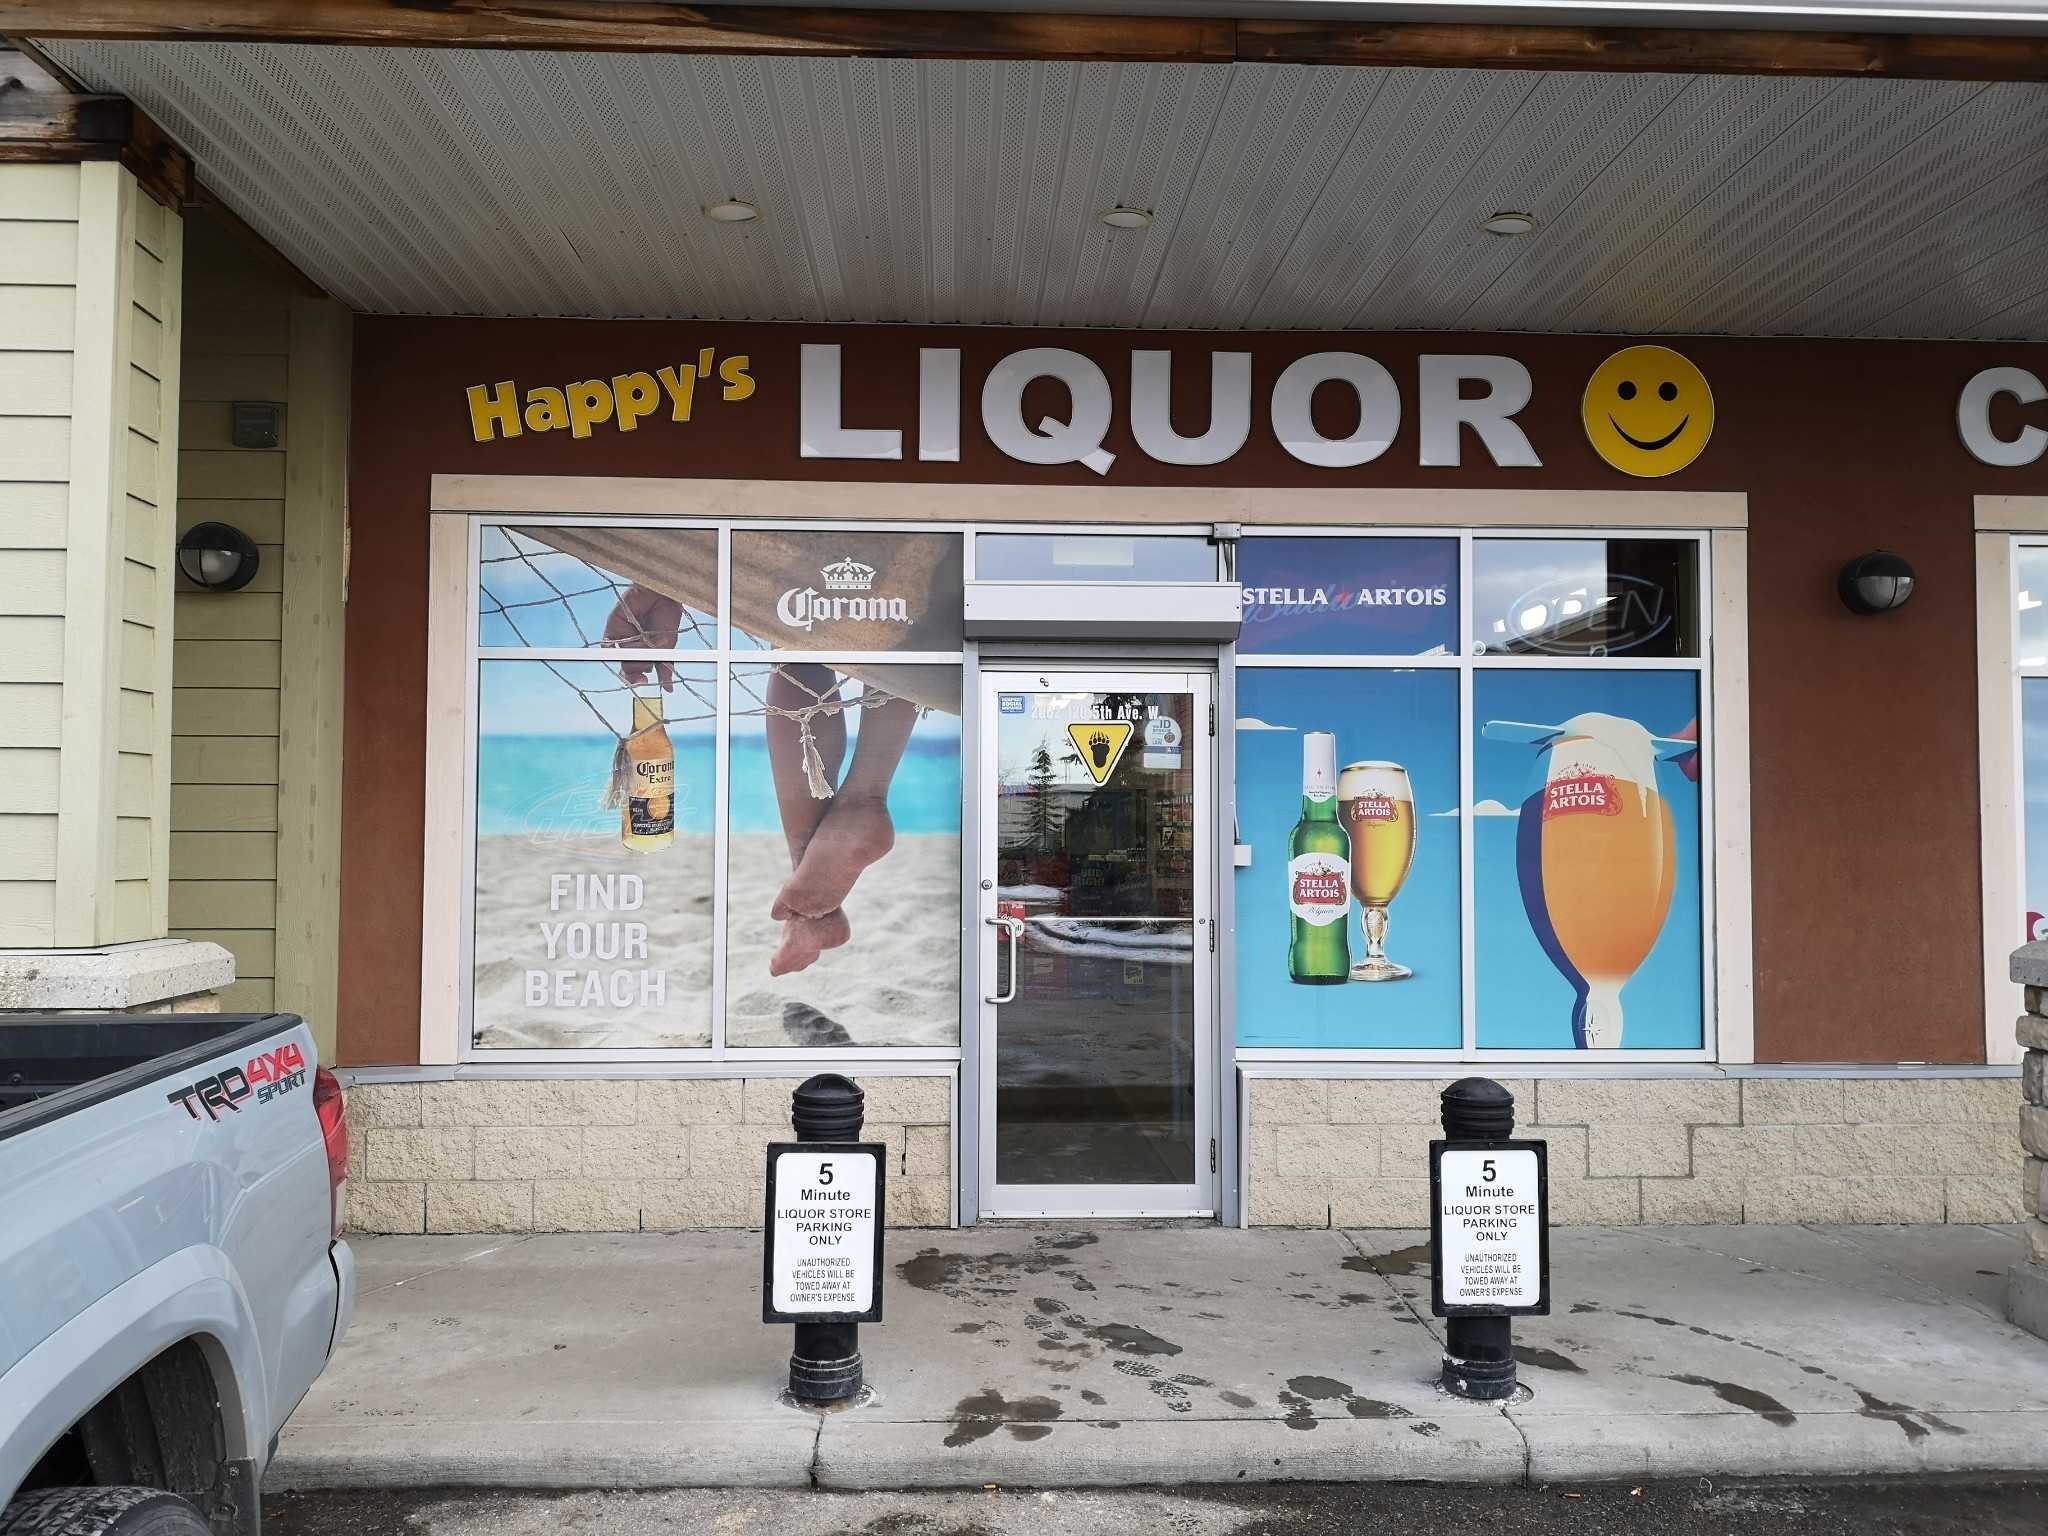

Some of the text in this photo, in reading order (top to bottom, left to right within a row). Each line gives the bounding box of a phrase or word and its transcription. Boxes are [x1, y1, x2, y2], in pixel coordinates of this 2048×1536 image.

[466, 343, 1544, 477] Happy's LIQUOR
[1242, 587, 1448, 606] STELLA ARTOIS
[776, 586, 910, 632] Corona
[1092, 705, 1112, 720] 5th
[1117, 705, 1143, 720] Ave.
[1148, 705, 1162, 720] W.
[1551, 782, 1605, 798] STELLA
[1358, 801, 1391, 809] STELLA
[1549, 794, 1606, 811] ARTOIS
[1358, 808, 1391, 816] ARTOIS
[1300, 879, 1339, 889] STELLA
[550, 873, 644, 911] FIND
[1300, 888, 1340, 899] ARTOIS
[540, 921, 648, 960] YOUR
[525, 969, 666, 1008] BEACH
[257, 1068, 307, 1104] SPORT
[166, 1066, 254, 1122] TRD
[818, 1162, 834, 1185] 5
[1482, 1159, 1497, 1183] 5
[801, 1189, 851, 1201] Minute
[1465, 1185, 1514, 1198] Minute
[777, 1208, 872, 1219] LIQUOR STORE
[1444, 1204, 1536, 1216] LIQUOR STORE
[796, 1222, 853, 1232] PARKING
[1463, 1218, 1517, 1228] PARKING
[809, 1235, 842, 1246] ONLY
[1476, 1231, 1508, 1241] ONLY
[797, 1257, 851, 1267] UNAUTHORIZED
[1465, 1253, 1517, 1262] UNAUTHORIZED
[792, 1269, 855, 1279] VEHICLES WILL BE
[1460, 1265, 1521, 1274] VEHICLES WILL BE
[796, 1281, 851, 1291] TOWED AWAY AT
[1465, 1276, 1518, 1286] TOWED AWAY AT
[790, 1293, 855, 1302] OWNER'S EXPENSE
[1459, 1287, 1523, 1297] OWNER'S EXPENSE
